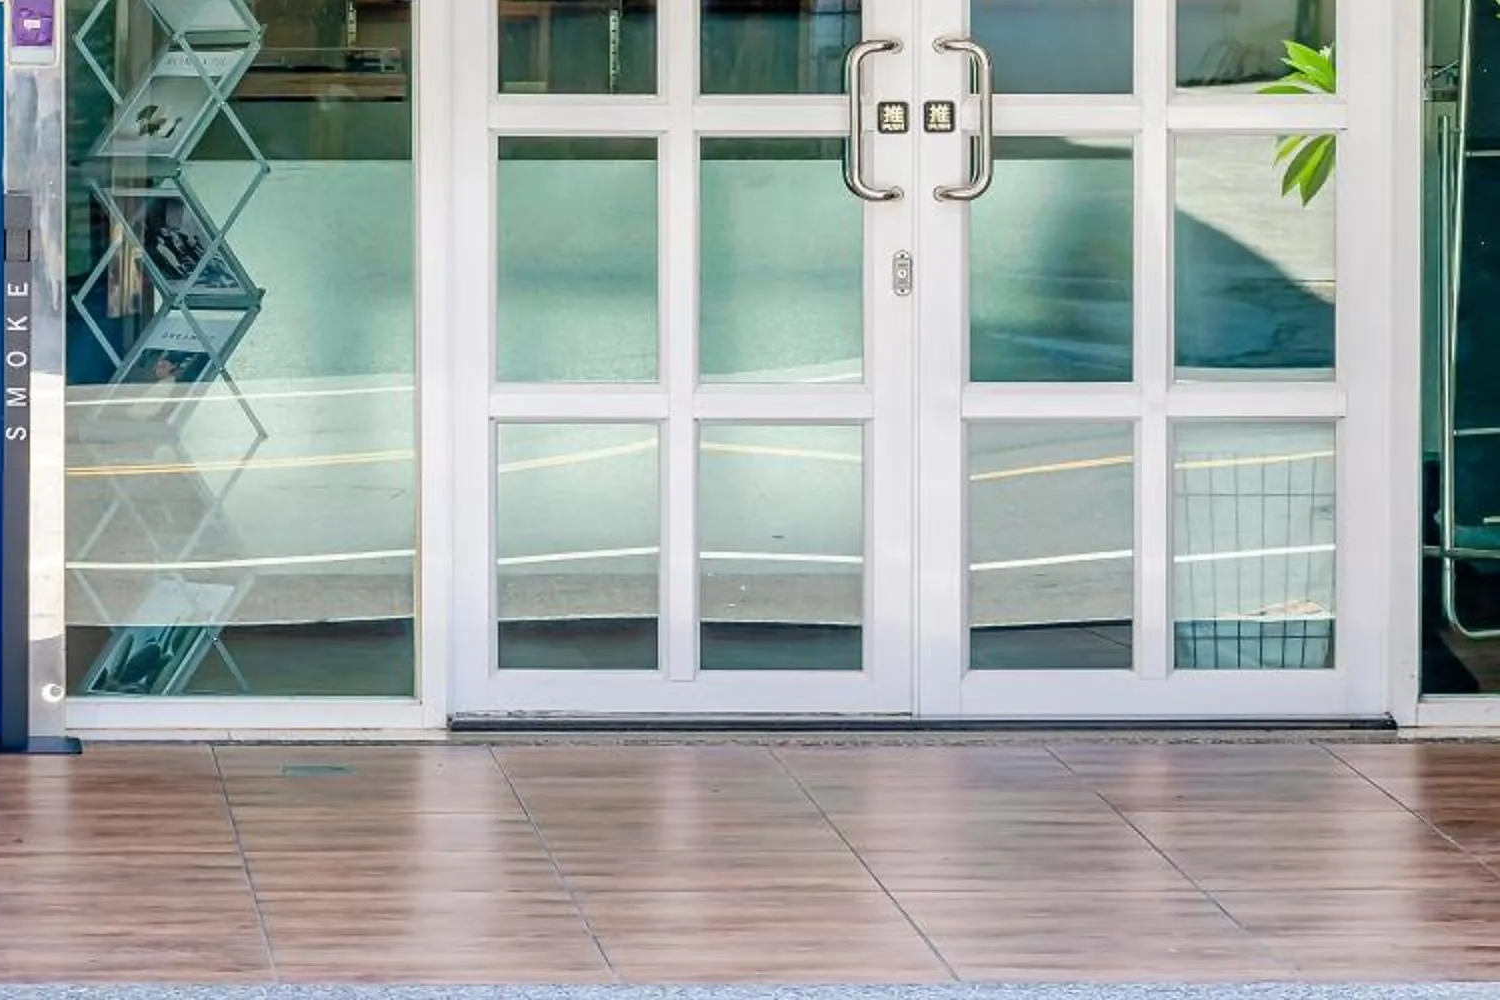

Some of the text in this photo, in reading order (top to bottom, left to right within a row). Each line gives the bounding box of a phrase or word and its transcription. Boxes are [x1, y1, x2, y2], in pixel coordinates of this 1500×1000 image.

[884, 104, 904, 122] 推
[929, 104, 951, 122] 推
[6, 283, 29, 441] SMOKE
